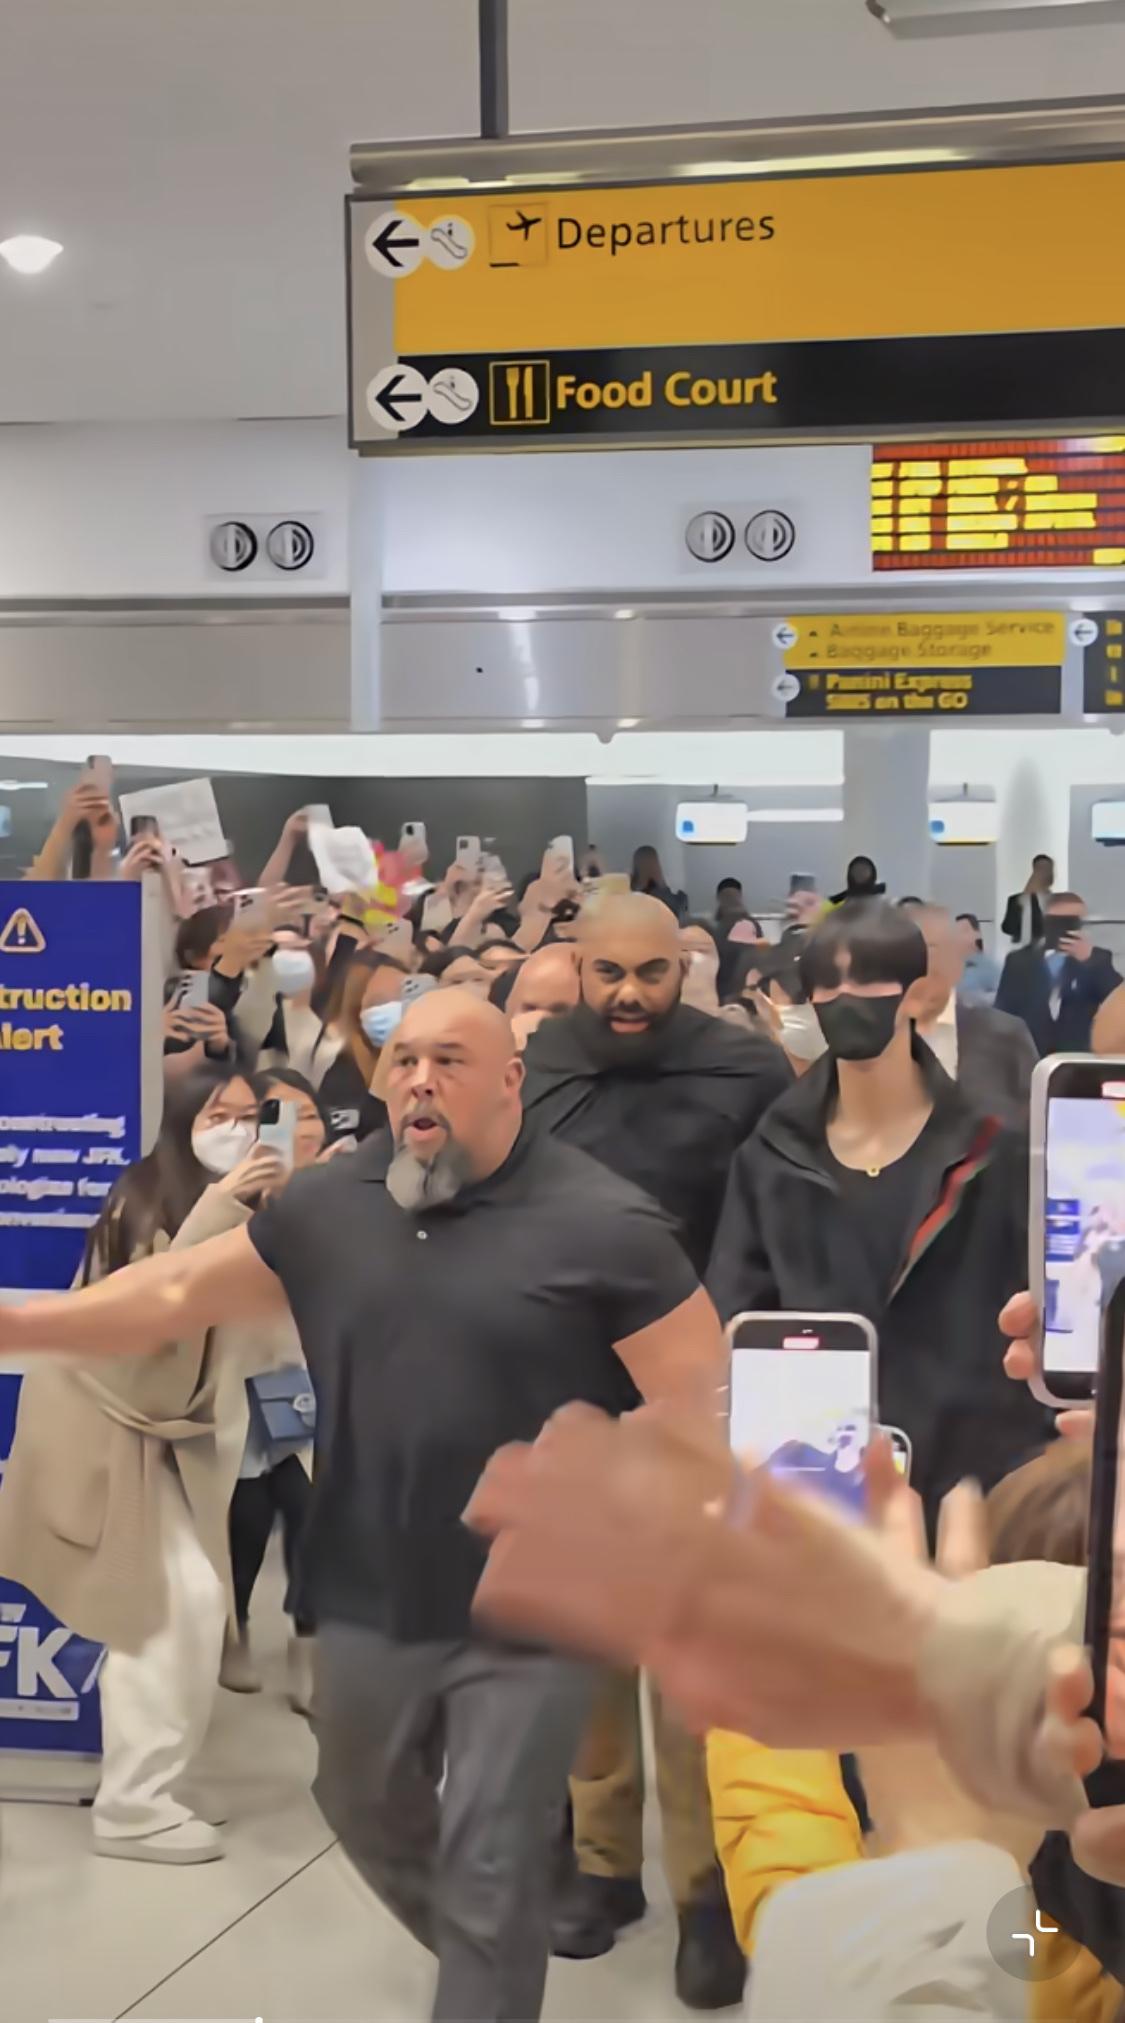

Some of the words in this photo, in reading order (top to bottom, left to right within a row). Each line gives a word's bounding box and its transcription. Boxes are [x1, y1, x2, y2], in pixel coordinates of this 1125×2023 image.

[557, 215, 776, 257] Departures
[556, 370, 652, 410] Food
[664, 370, 778, 407] Court
[897, 622, 979, 640] Baggage
[986, 620, 1055, 636] Service
[827, 644, 912, 661] Baggage
[917, 642, 992, 661] Storage
[938, 691, 968, 709] GO
[0, 1022, 64, 1051] lert
